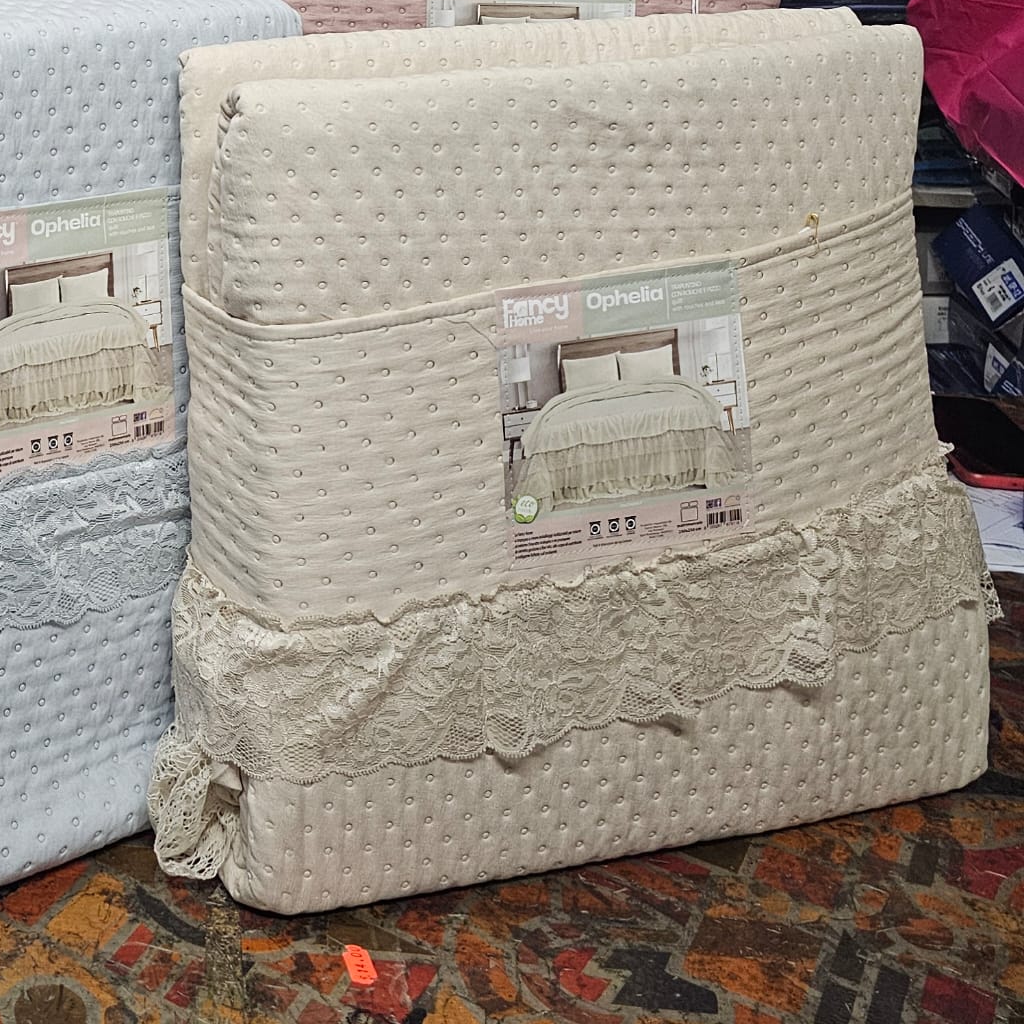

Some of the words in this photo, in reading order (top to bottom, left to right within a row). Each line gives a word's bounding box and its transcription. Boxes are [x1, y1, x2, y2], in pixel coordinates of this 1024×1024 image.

[30, 212, 102, 238] Ophelia
[502, 294, 570, 329] Fancy
[586, 285, 664, 312] Ophelia
[508, 314, 545, 328] Home
